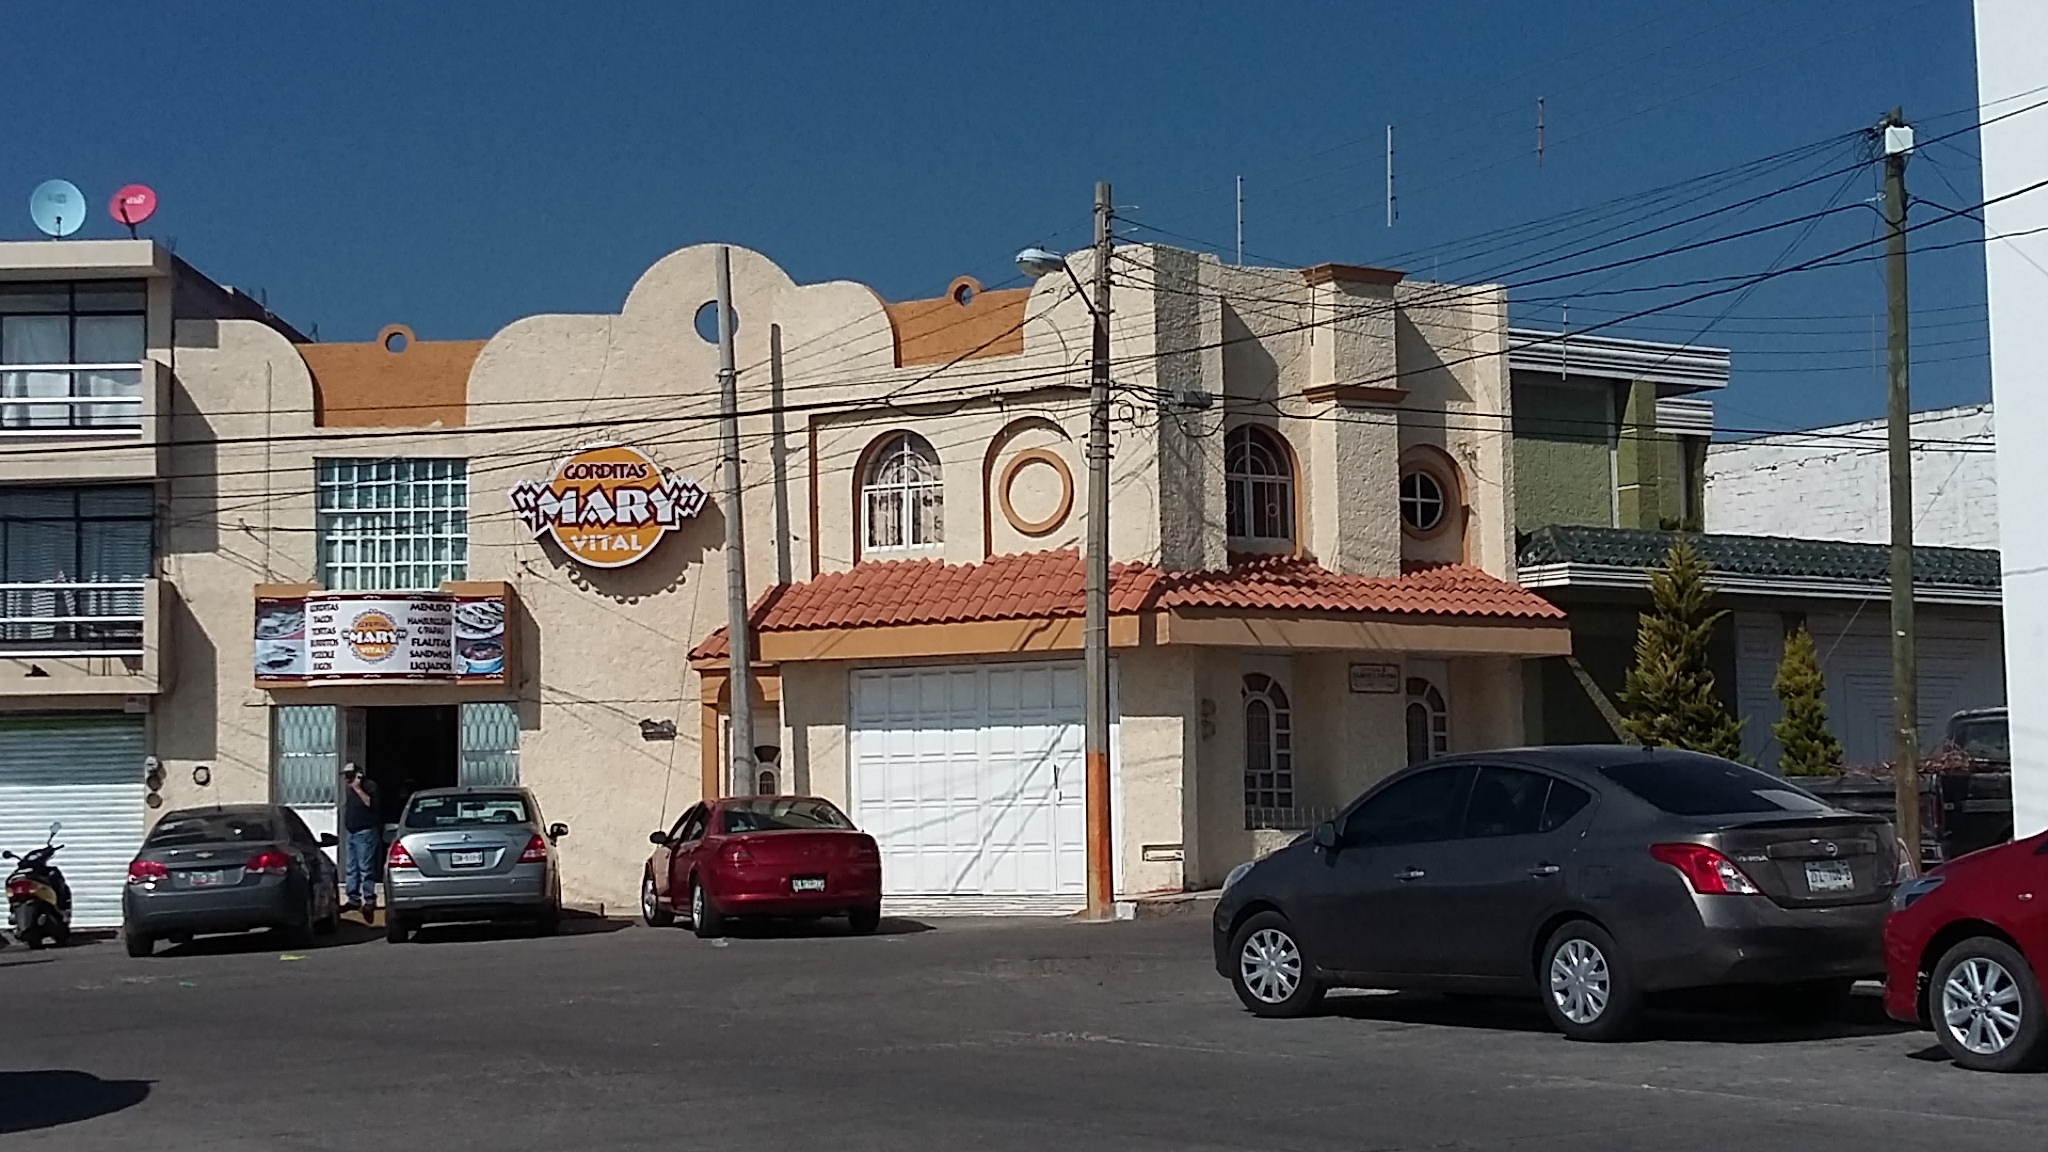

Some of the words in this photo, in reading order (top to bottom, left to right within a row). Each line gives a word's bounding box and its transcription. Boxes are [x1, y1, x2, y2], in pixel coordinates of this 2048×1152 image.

[563, 462, 648, 479] GORDITAS
[570, 535, 643, 551] VITAL
[410, 603, 452, 612] MENUDO
[313, 615, 334, 624] TACOS
[411, 638, 451, 647] FLAUTAS
[360, 646, 387, 654] VITAL
[410, 650, 452, 659] SANDWICH
[313, 662, 333, 671] JUGOS
[410, 661, 452, 673] LICUADOS
